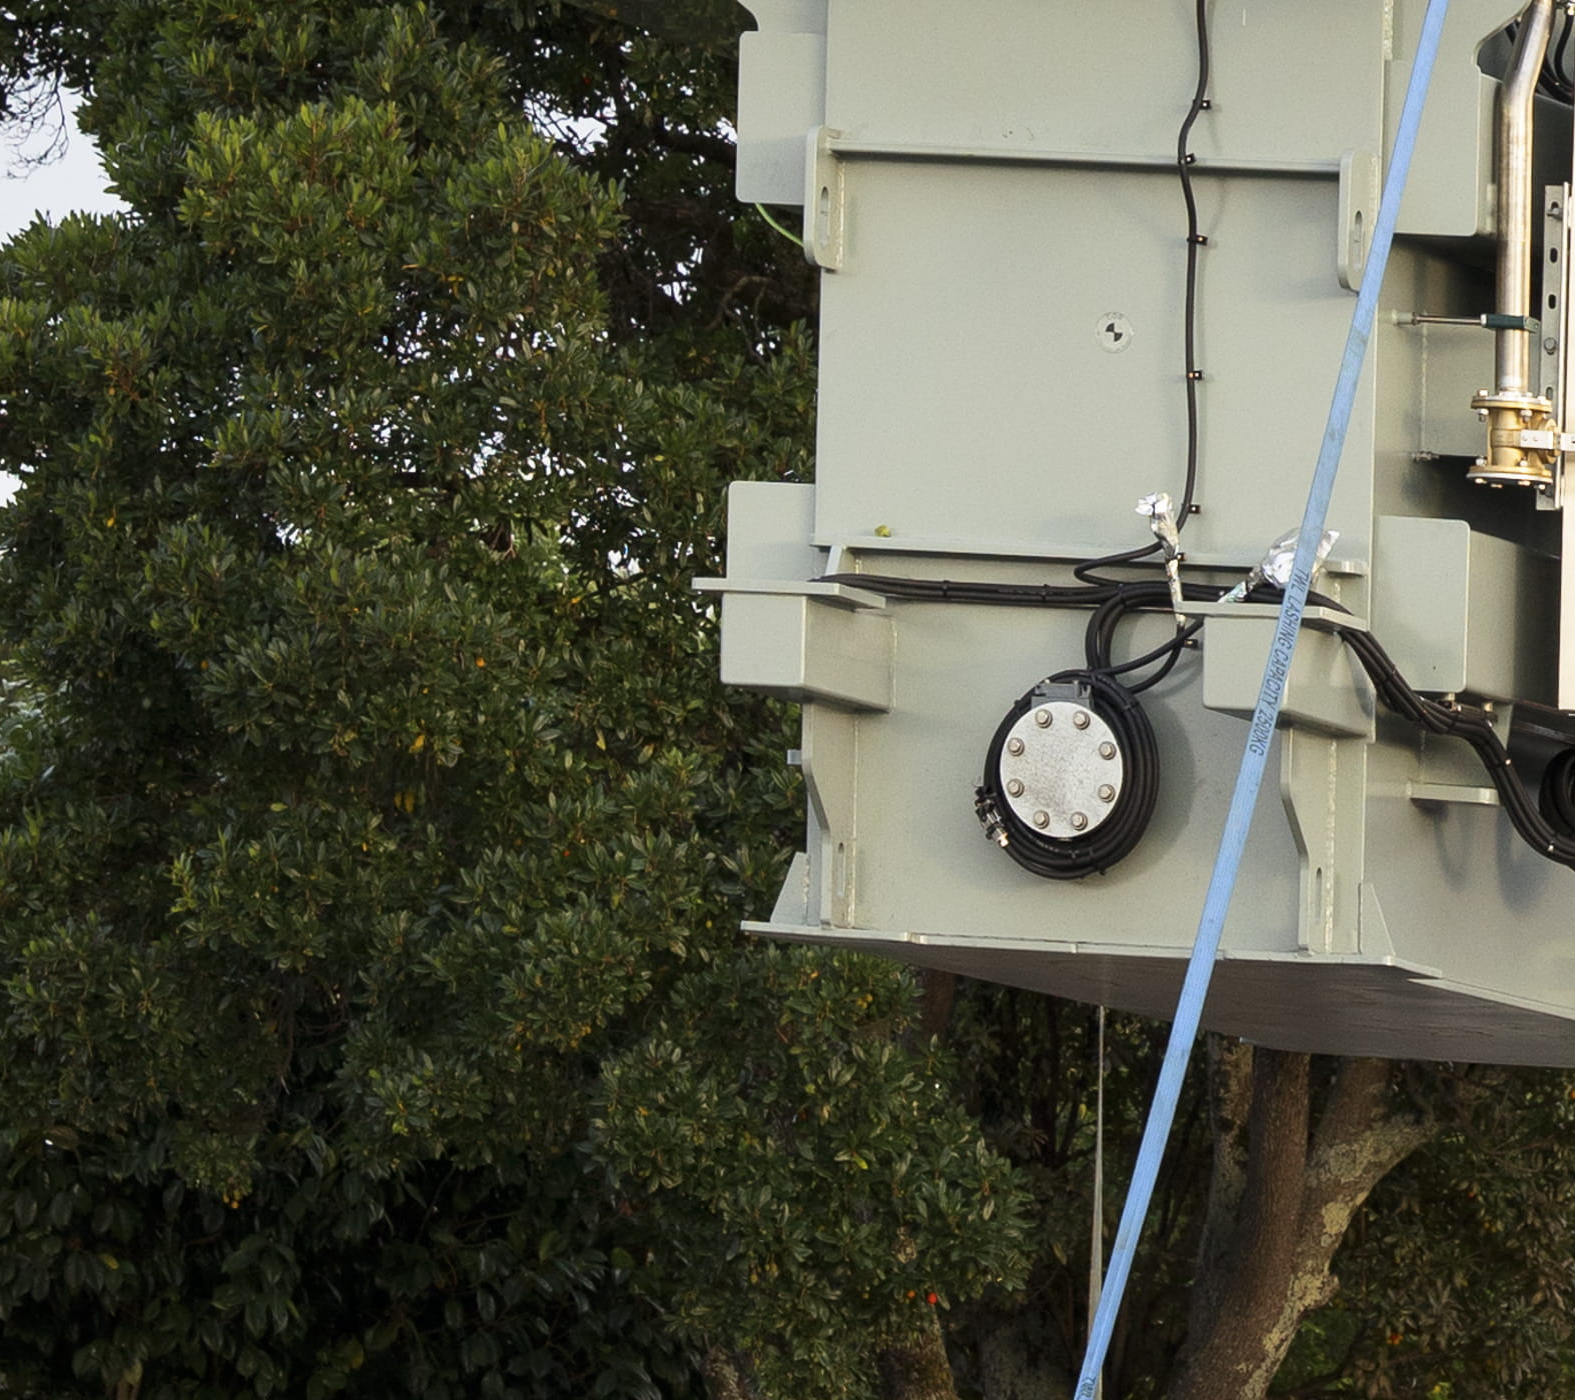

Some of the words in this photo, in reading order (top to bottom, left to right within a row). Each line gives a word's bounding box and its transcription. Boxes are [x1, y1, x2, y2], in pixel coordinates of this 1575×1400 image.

[1291, 568, 1309, 593] TWL
[1276, 595, 1302, 649] LASHING
[1260, 648, 1287, 709] CAPACITY
[1249, 708, 1273, 757] 2500KG
